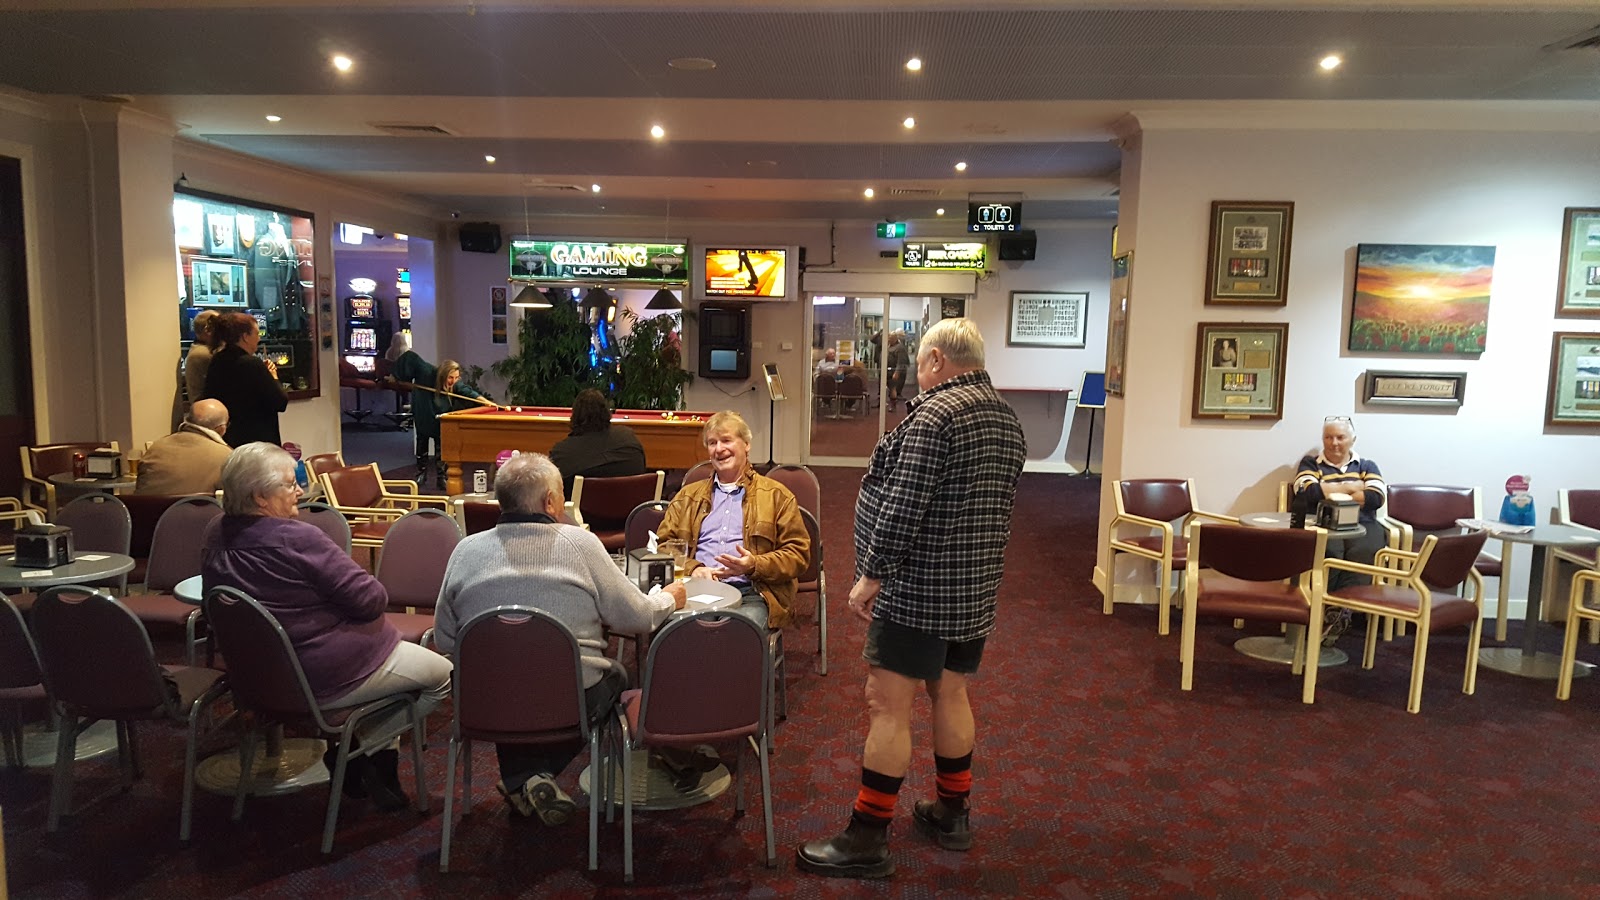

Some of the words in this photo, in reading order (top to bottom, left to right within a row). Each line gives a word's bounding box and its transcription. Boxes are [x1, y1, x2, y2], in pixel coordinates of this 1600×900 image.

[550, 244, 648, 267] GAMING
[572, 267, 628, 276] LOUNGE
[1381, 383, 1401, 391] LEST
[1403, 383, 1416, 391] WE
[1417, 383, 1452, 392] FORGET
